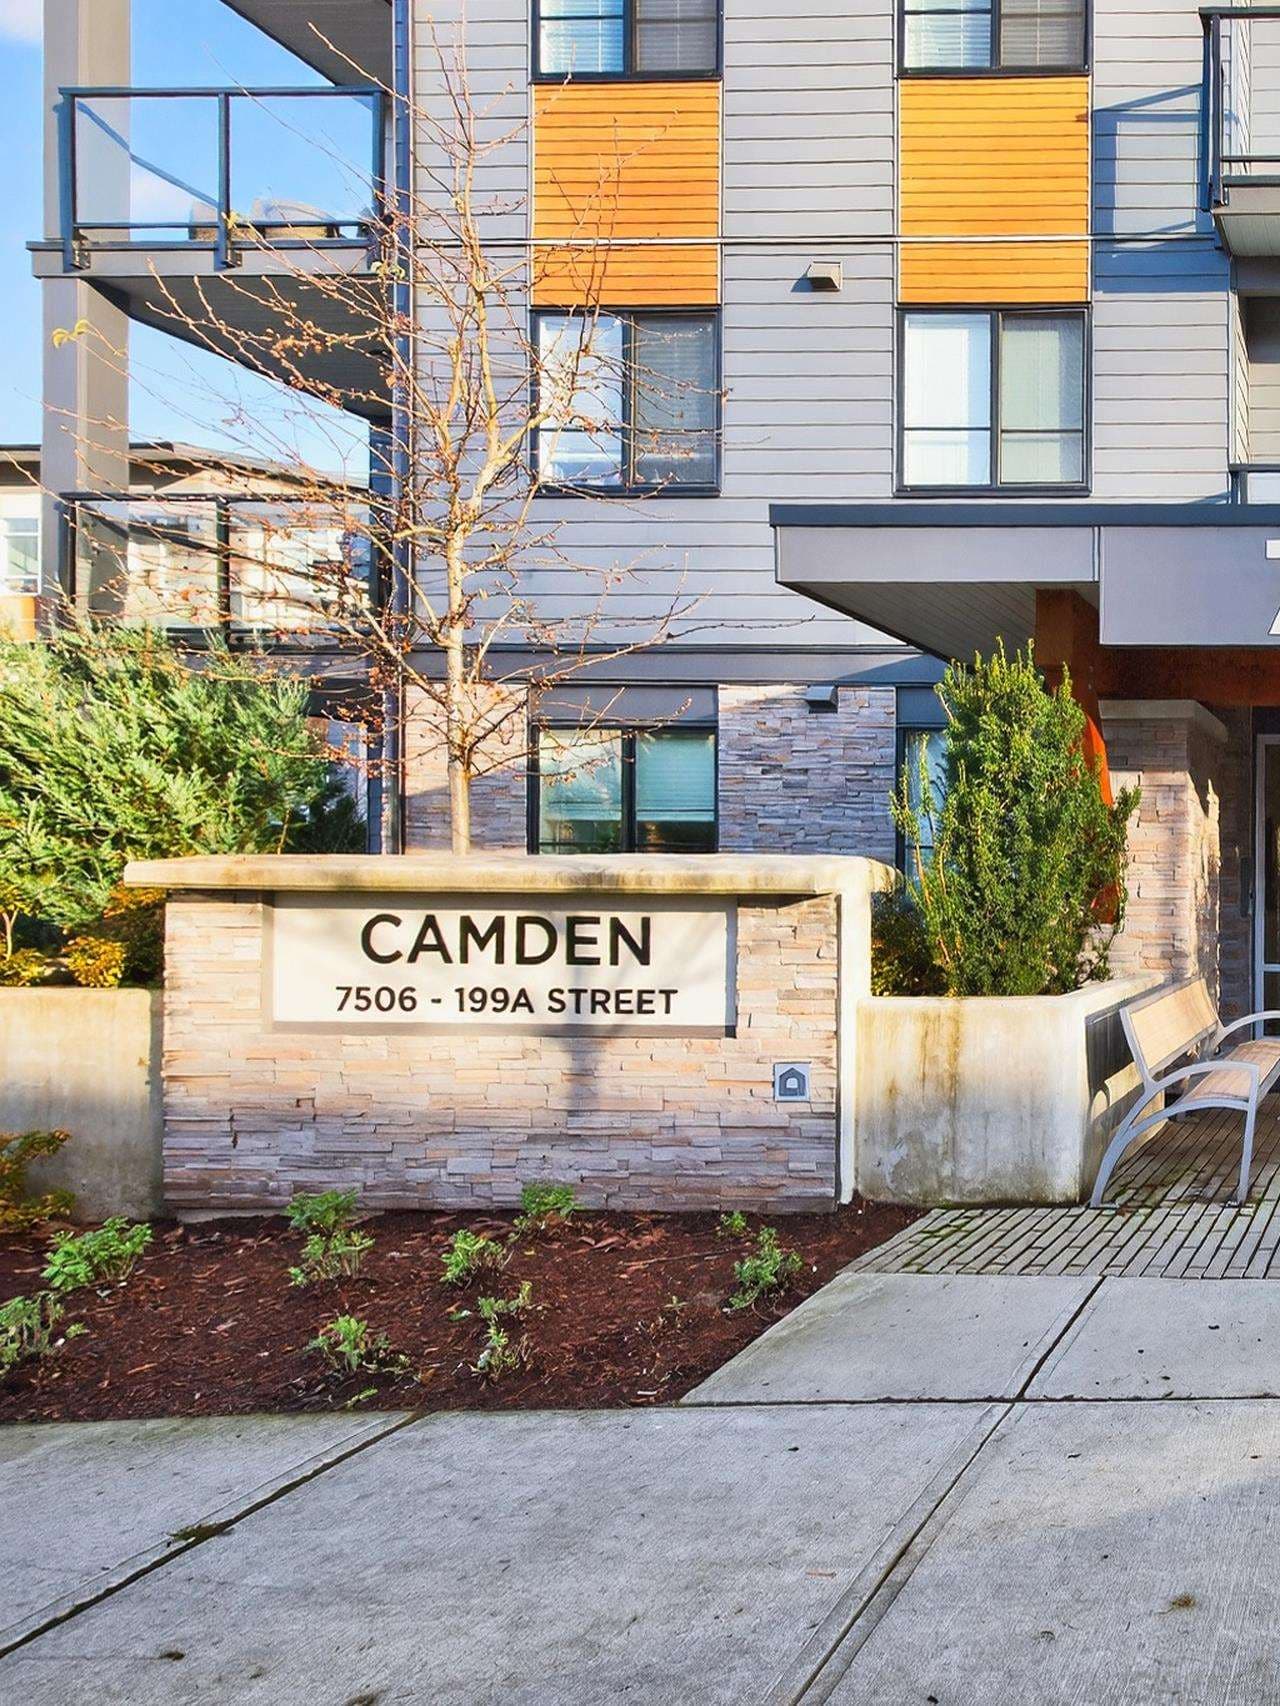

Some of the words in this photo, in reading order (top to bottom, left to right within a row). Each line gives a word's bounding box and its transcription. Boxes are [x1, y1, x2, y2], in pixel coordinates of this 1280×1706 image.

[360, 913, 651, 967] CAMDEN
[335, 986, 418, 1013] 7506
[454, 987, 535, 1014] 199A
[547, 988, 679, 1015] STREET
